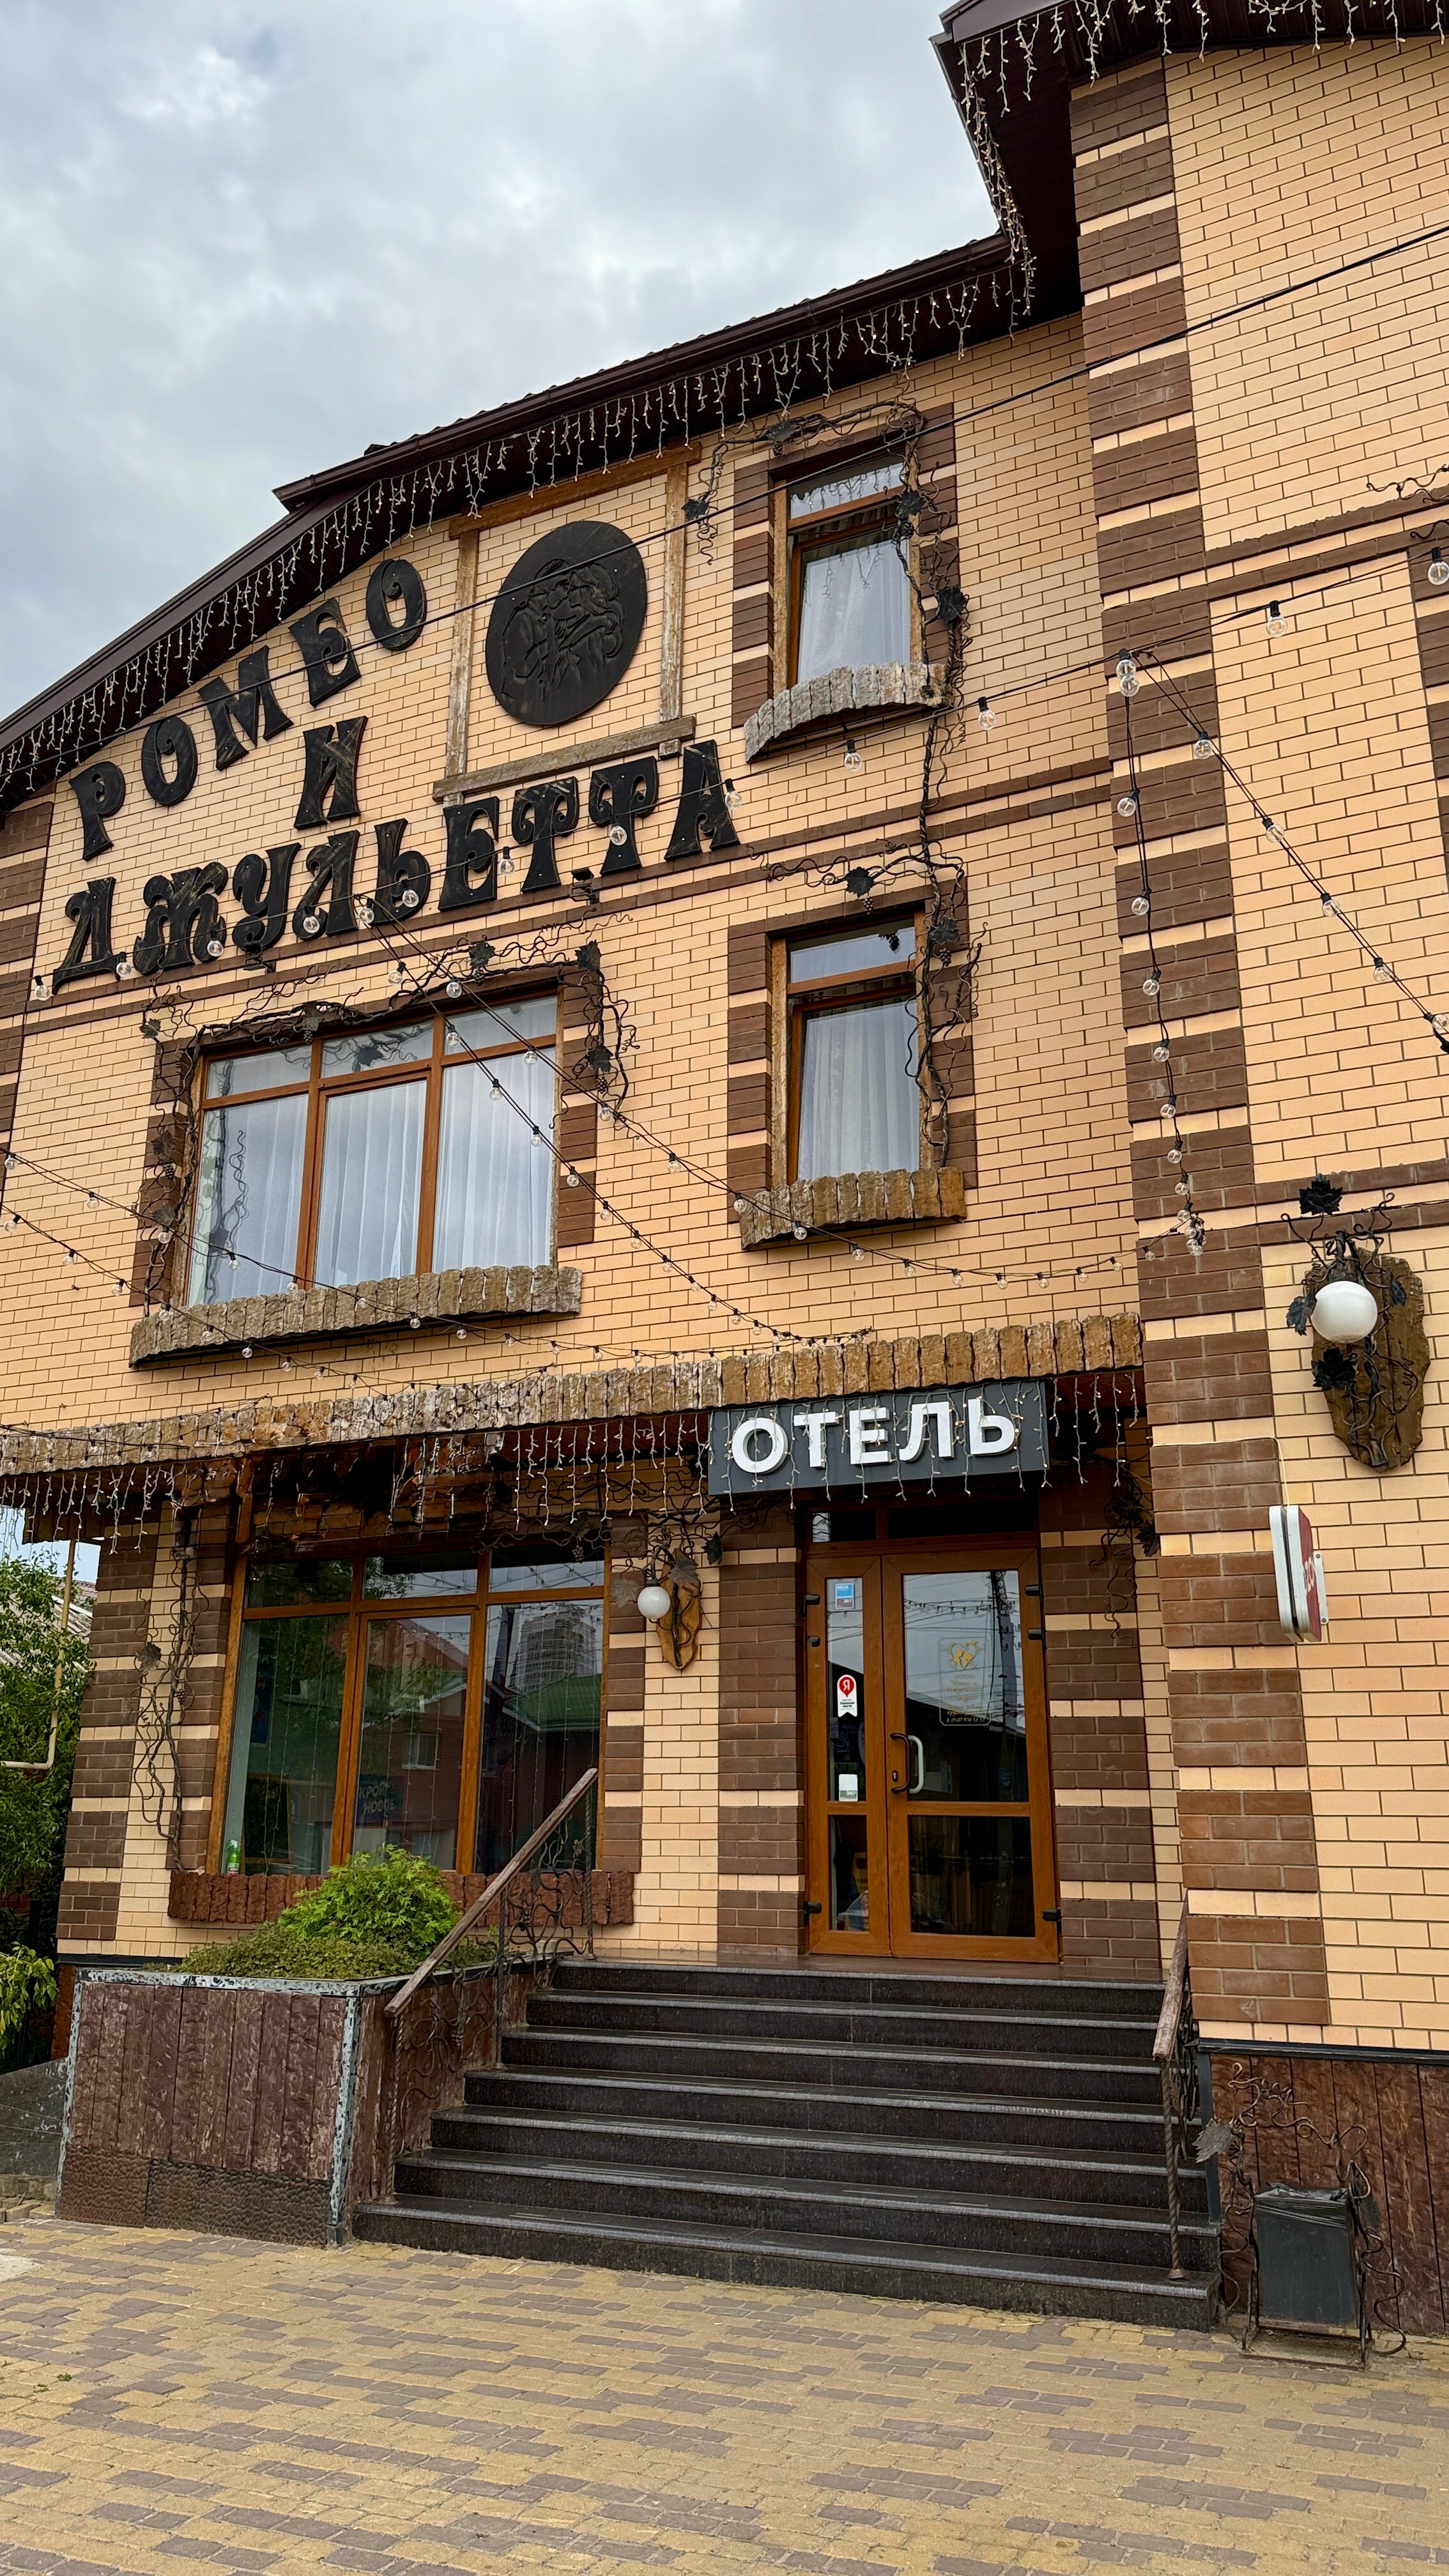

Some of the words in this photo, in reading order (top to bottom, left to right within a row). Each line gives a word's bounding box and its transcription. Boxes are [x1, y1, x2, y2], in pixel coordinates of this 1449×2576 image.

[70, 558, 427, 861] РОМЕО
[293, 716, 368, 830] И
[52, 739, 742, 996] ДЖУЛЬЕТТА
[731, 1399, 1018, 1475] ОТЕЛЬ
[843, 1679, 850, 1691] Я
